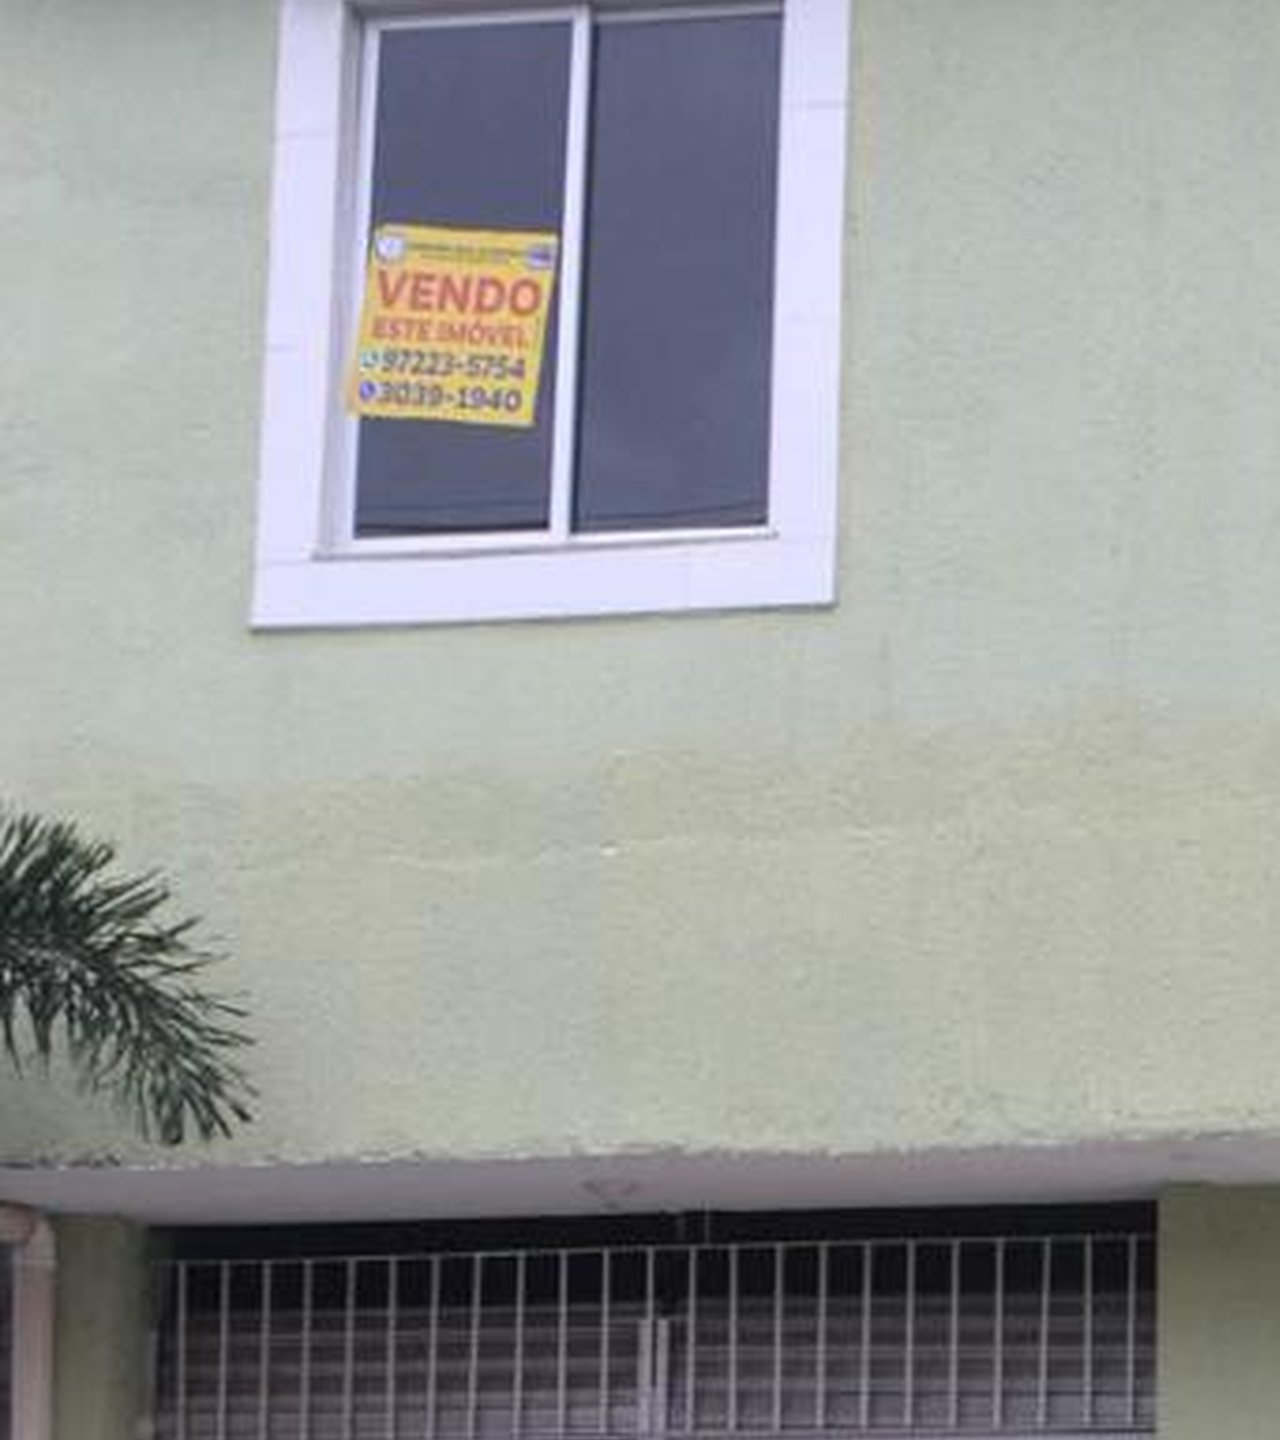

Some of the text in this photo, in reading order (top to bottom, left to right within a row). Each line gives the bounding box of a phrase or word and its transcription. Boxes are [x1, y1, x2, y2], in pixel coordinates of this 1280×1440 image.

[376, 269, 543, 316] VENDO
[372, 317, 529, 348] ESTE IMÓVEL
[381, 348, 526, 379] 97223-5754
[377, 380, 522, 411] 3039-1940
